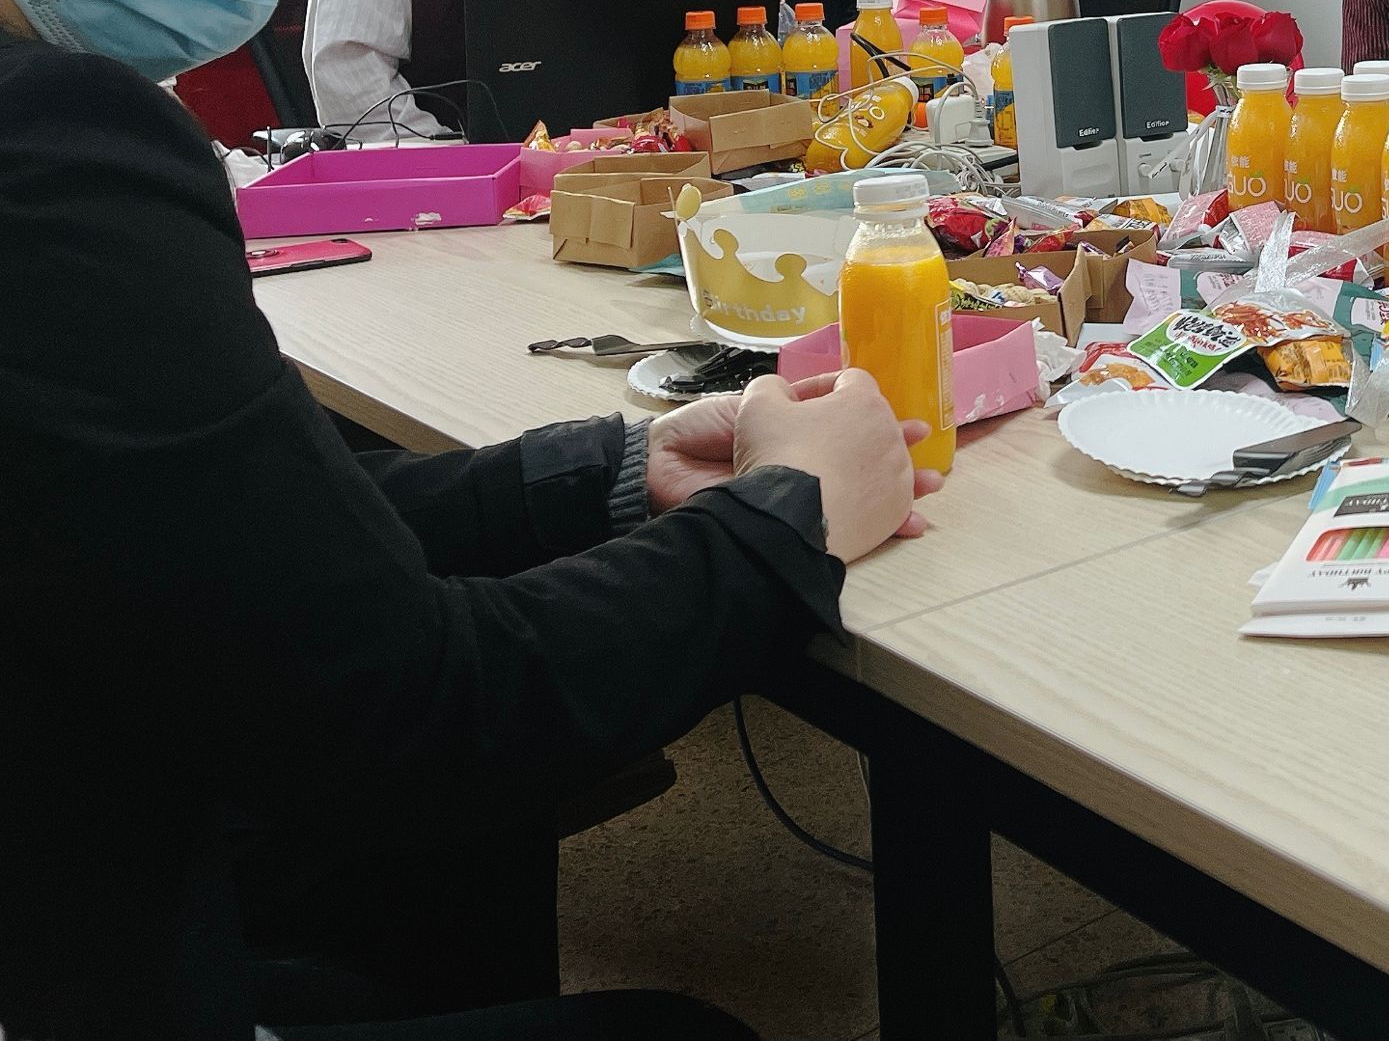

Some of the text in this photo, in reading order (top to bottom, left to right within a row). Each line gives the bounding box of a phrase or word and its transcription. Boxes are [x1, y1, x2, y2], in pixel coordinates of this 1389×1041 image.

[499, 61, 541, 72] acer
[1146, 120, 1169, 129] Edifier
[1079, 127, 1099, 137] Edifier
[1284, 178, 1312, 204] UO
[1308, 567, 1373, 578] BIRTHDAY
